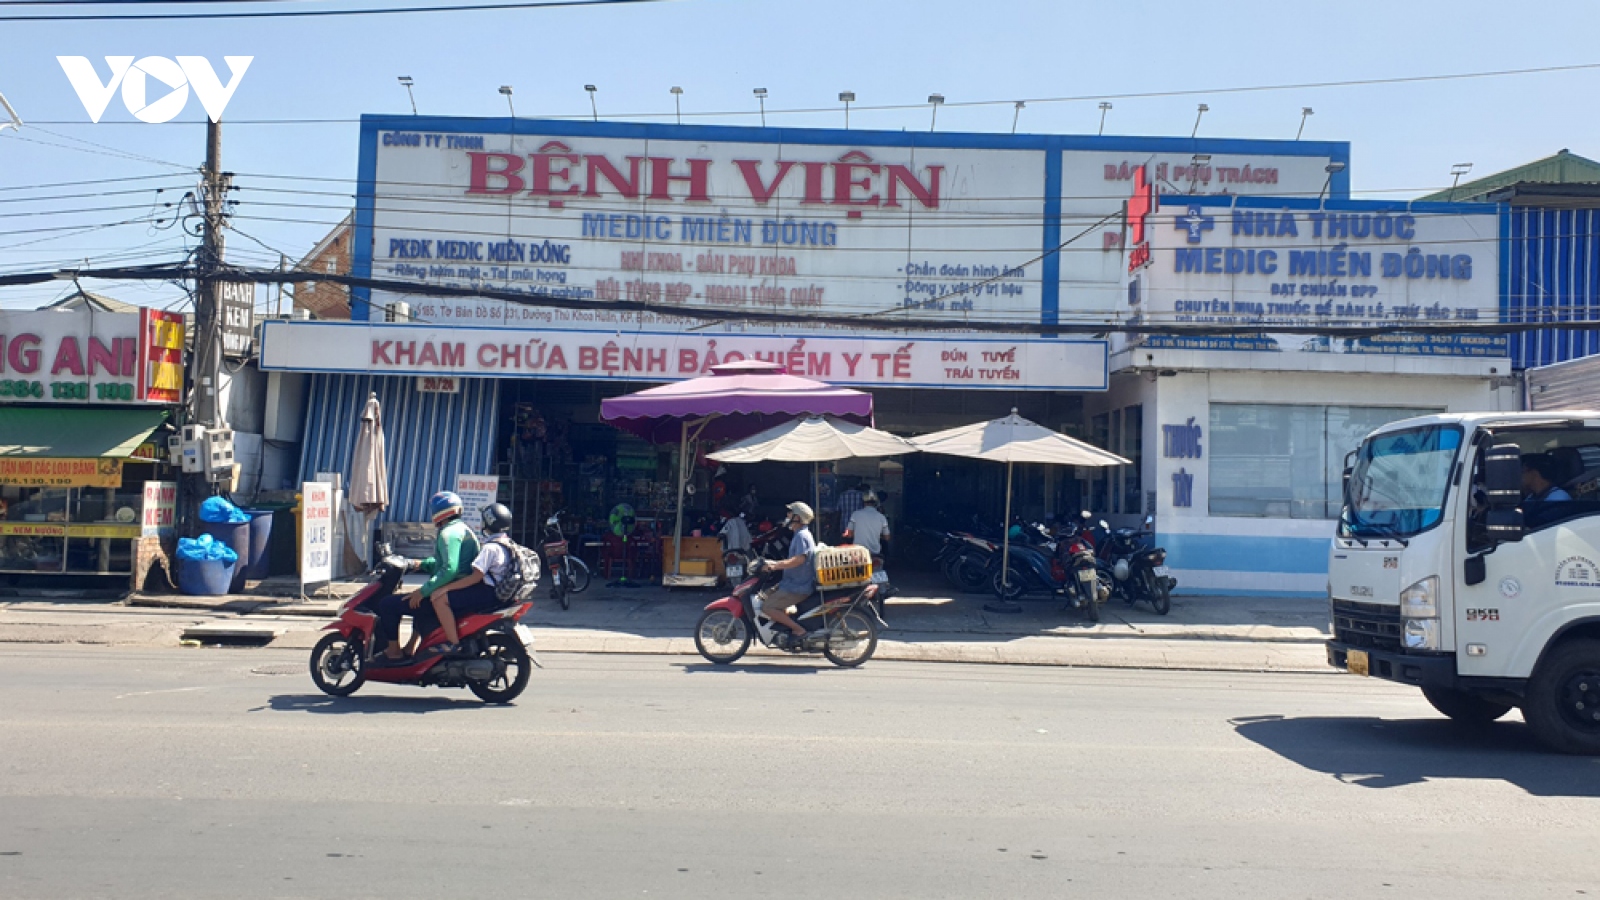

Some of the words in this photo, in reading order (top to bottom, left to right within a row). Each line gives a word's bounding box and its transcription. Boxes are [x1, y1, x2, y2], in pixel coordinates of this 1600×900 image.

[382, 131, 421, 147] CÔNG
[425, 134, 443, 148] TY
[446, 135, 484, 150] TNHH
[464, 141, 713, 208] BỆNH
[732, 150, 945, 218] VIỆN
[1216, 164, 1279, 184] TRÁCH
[581, 212, 672, 240] MEDIC
[761, 214, 838, 247] ĐÔNG
[1232, 207, 1299, 238] NHÀ
[1308, 206, 1416, 240] THUỐC
[388, 238, 432, 258] PKĐK
[437, 240, 483, 261] MEDIC
[530, 240, 571, 264] ĐÔNG
[647, 252, 683, 271] KHOA
[728, 255, 756, 278] PHỤ
[759, 256, 797, 275] KHOA
[939, 264, 969, 277] đoán
[1174, 248, 1278, 275] MEDIC
[1381, 247, 1473, 280] ĐÔNG
[536, 269, 567, 283] họng
[1175, 298, 1230, 312] CHUYÊN
[1267, 299, 1311, 315] THUỐC
[477, 338, 569, 369] CHỮA
[578, 340, 667, 377] BỆNH
[841, 353, 862, 377] Y
[871, 342, 915, 378] TẾ
[944, 366, 974, 379] TRÁI
[50, 381, 89, 399] 130
[1162, 415, 1203, 458] THUỐC
[73, 460, 96, 474] BÁNH
